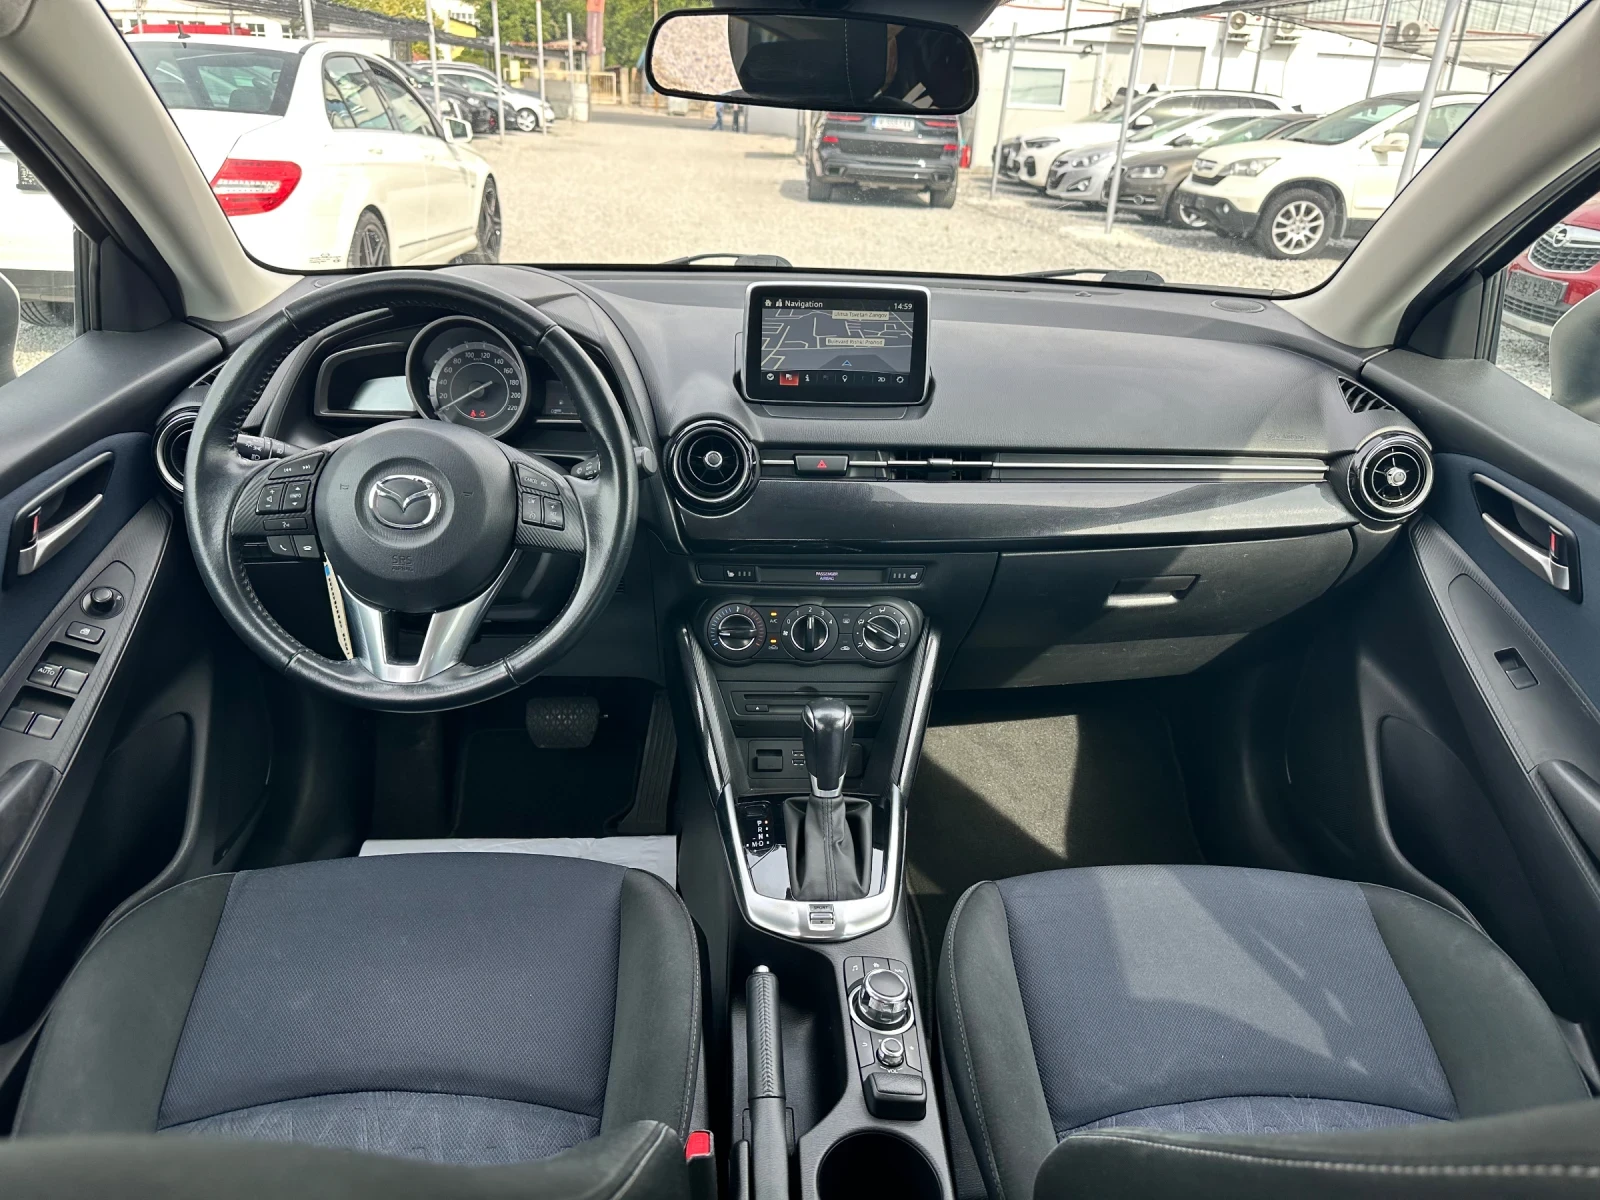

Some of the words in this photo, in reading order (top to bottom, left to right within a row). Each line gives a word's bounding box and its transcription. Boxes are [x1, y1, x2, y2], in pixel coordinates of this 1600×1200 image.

[784, 300, 823, 308] Navigation
[524, 476, 538, 484] CANCEL
[392, 555, 412, 564] SRS
[37, 667, 56, 676] AUTO
